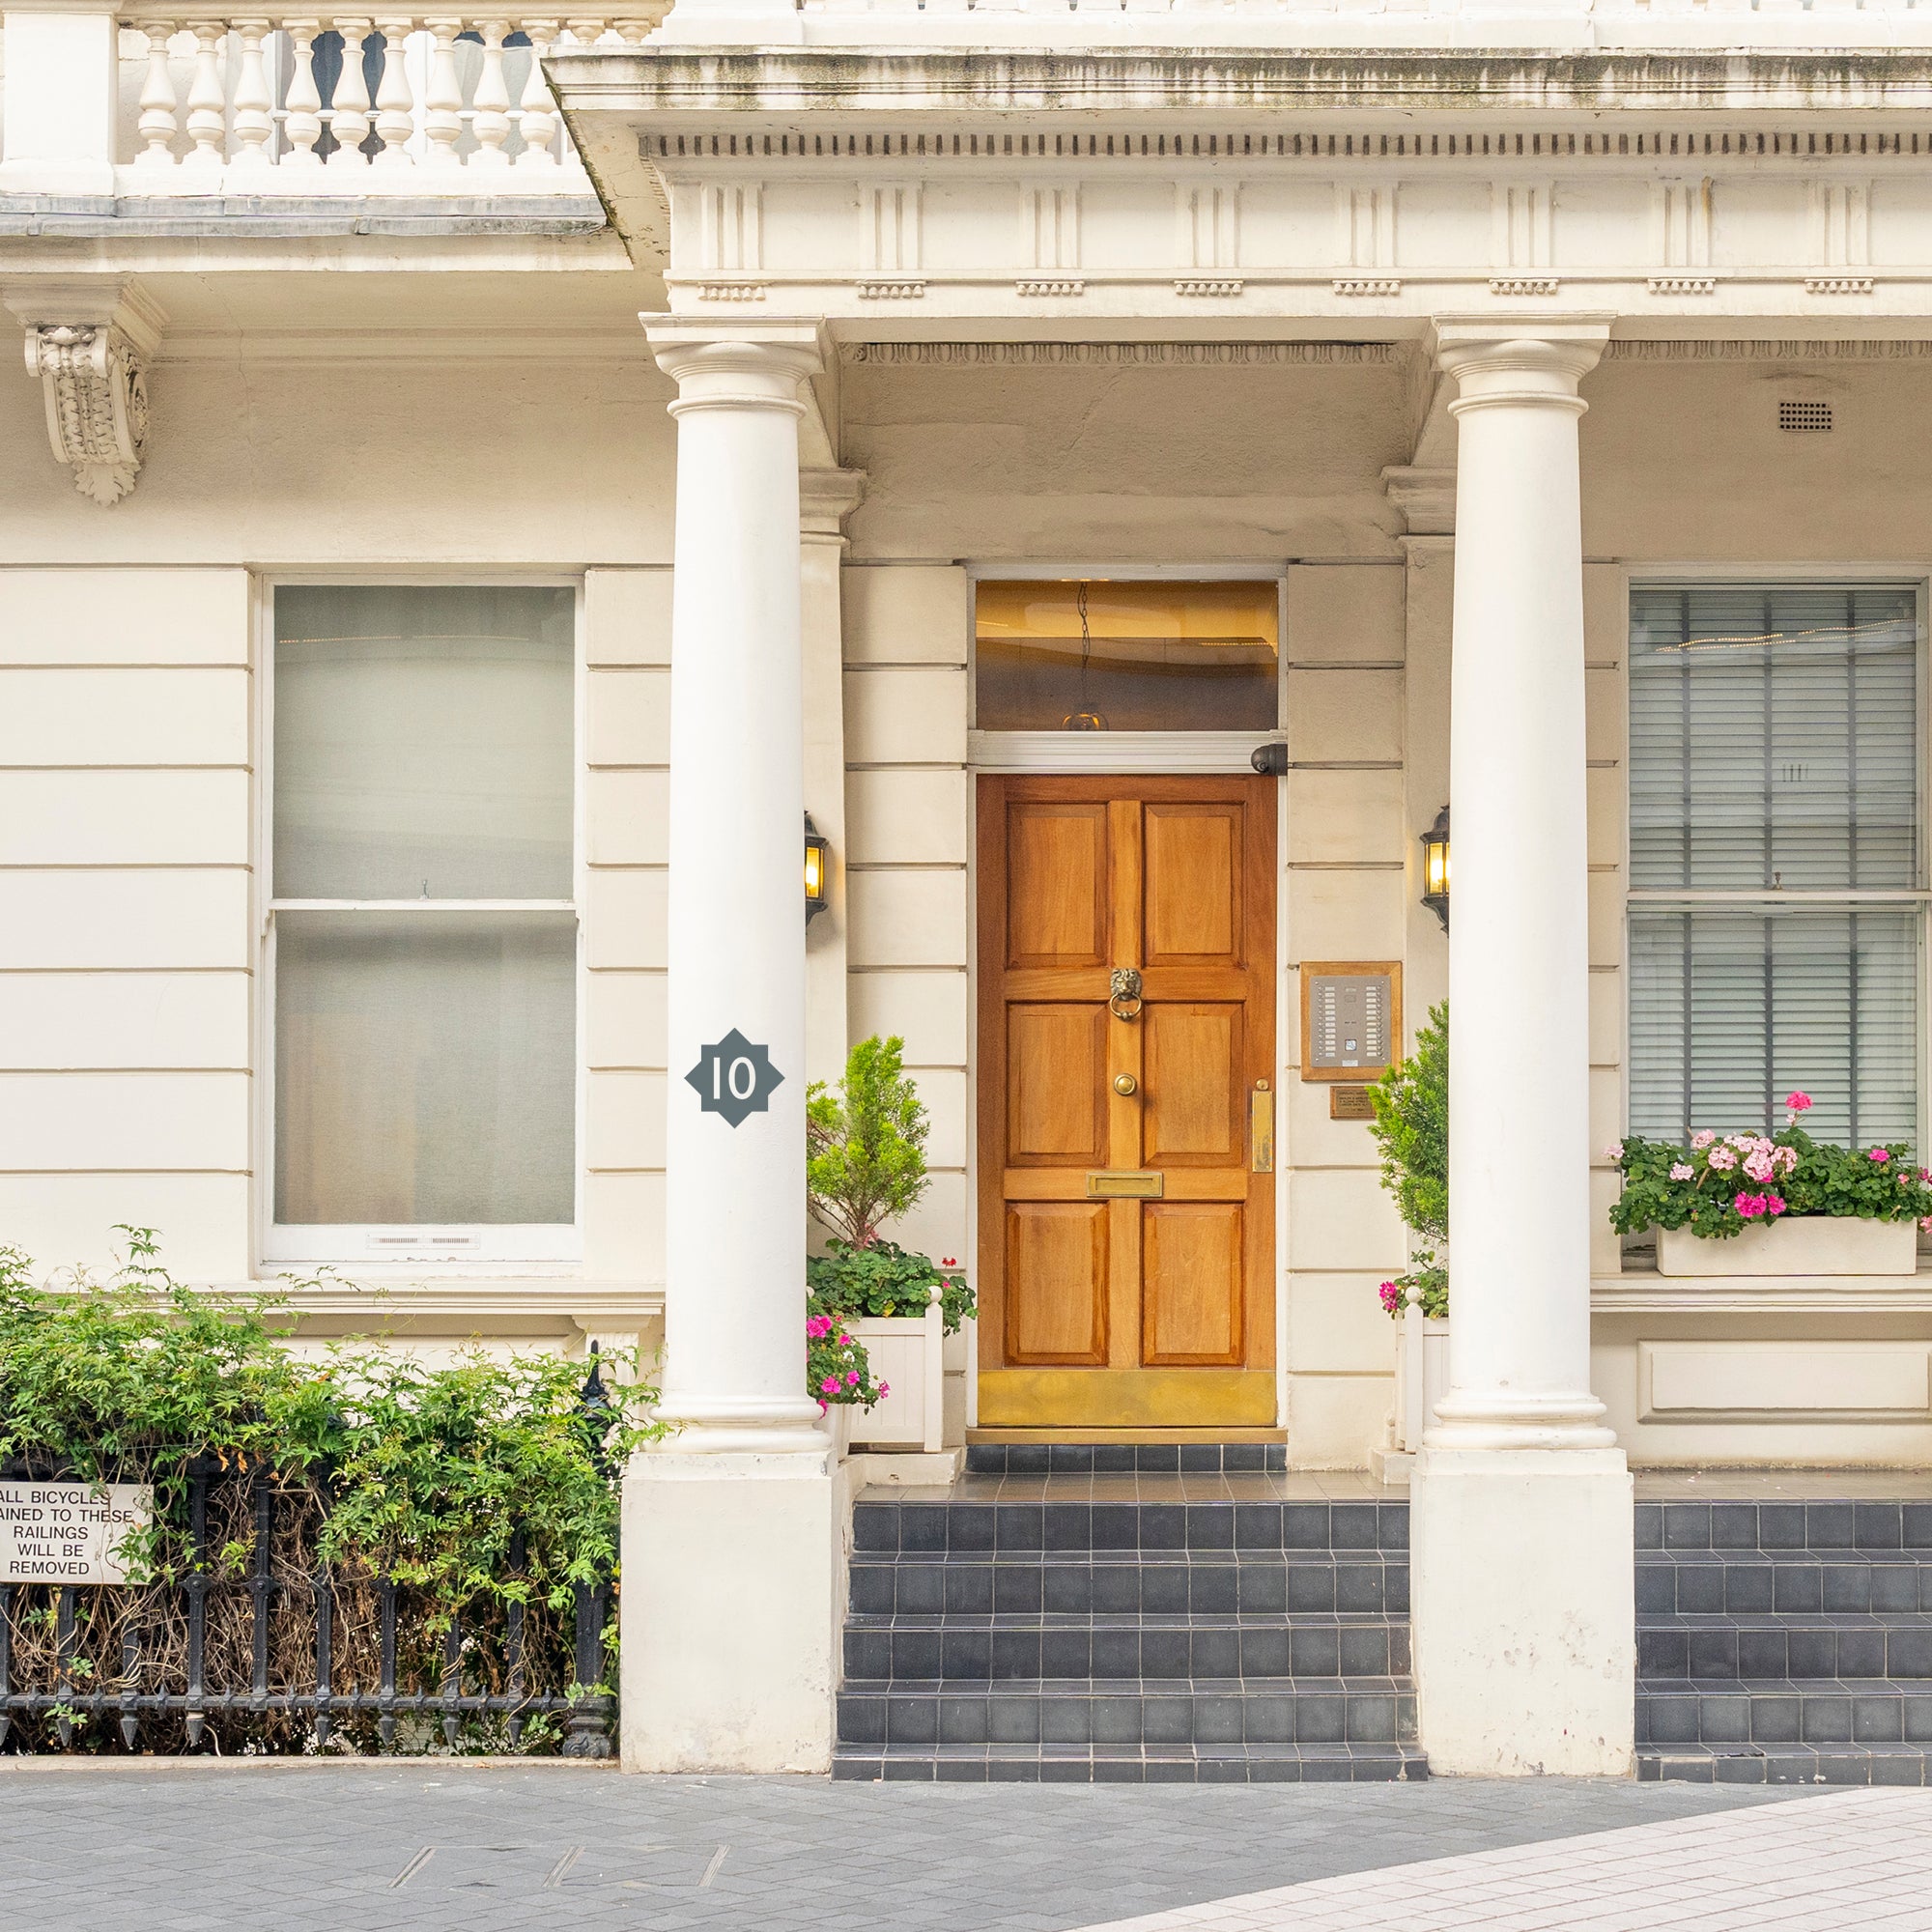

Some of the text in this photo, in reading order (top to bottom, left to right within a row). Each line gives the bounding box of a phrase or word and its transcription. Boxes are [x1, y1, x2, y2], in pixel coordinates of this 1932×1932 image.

[713, 1056, 756, 1100] 10
[51, 1508, 71, 1522] TO
[79, 1509, 133, 1523] THESE
[14, 1525, 89, 1540] RAILINGS
[17, 1543, 84, 1557] WILL BE
[10, 1561, 90, 1576] REMOVED
